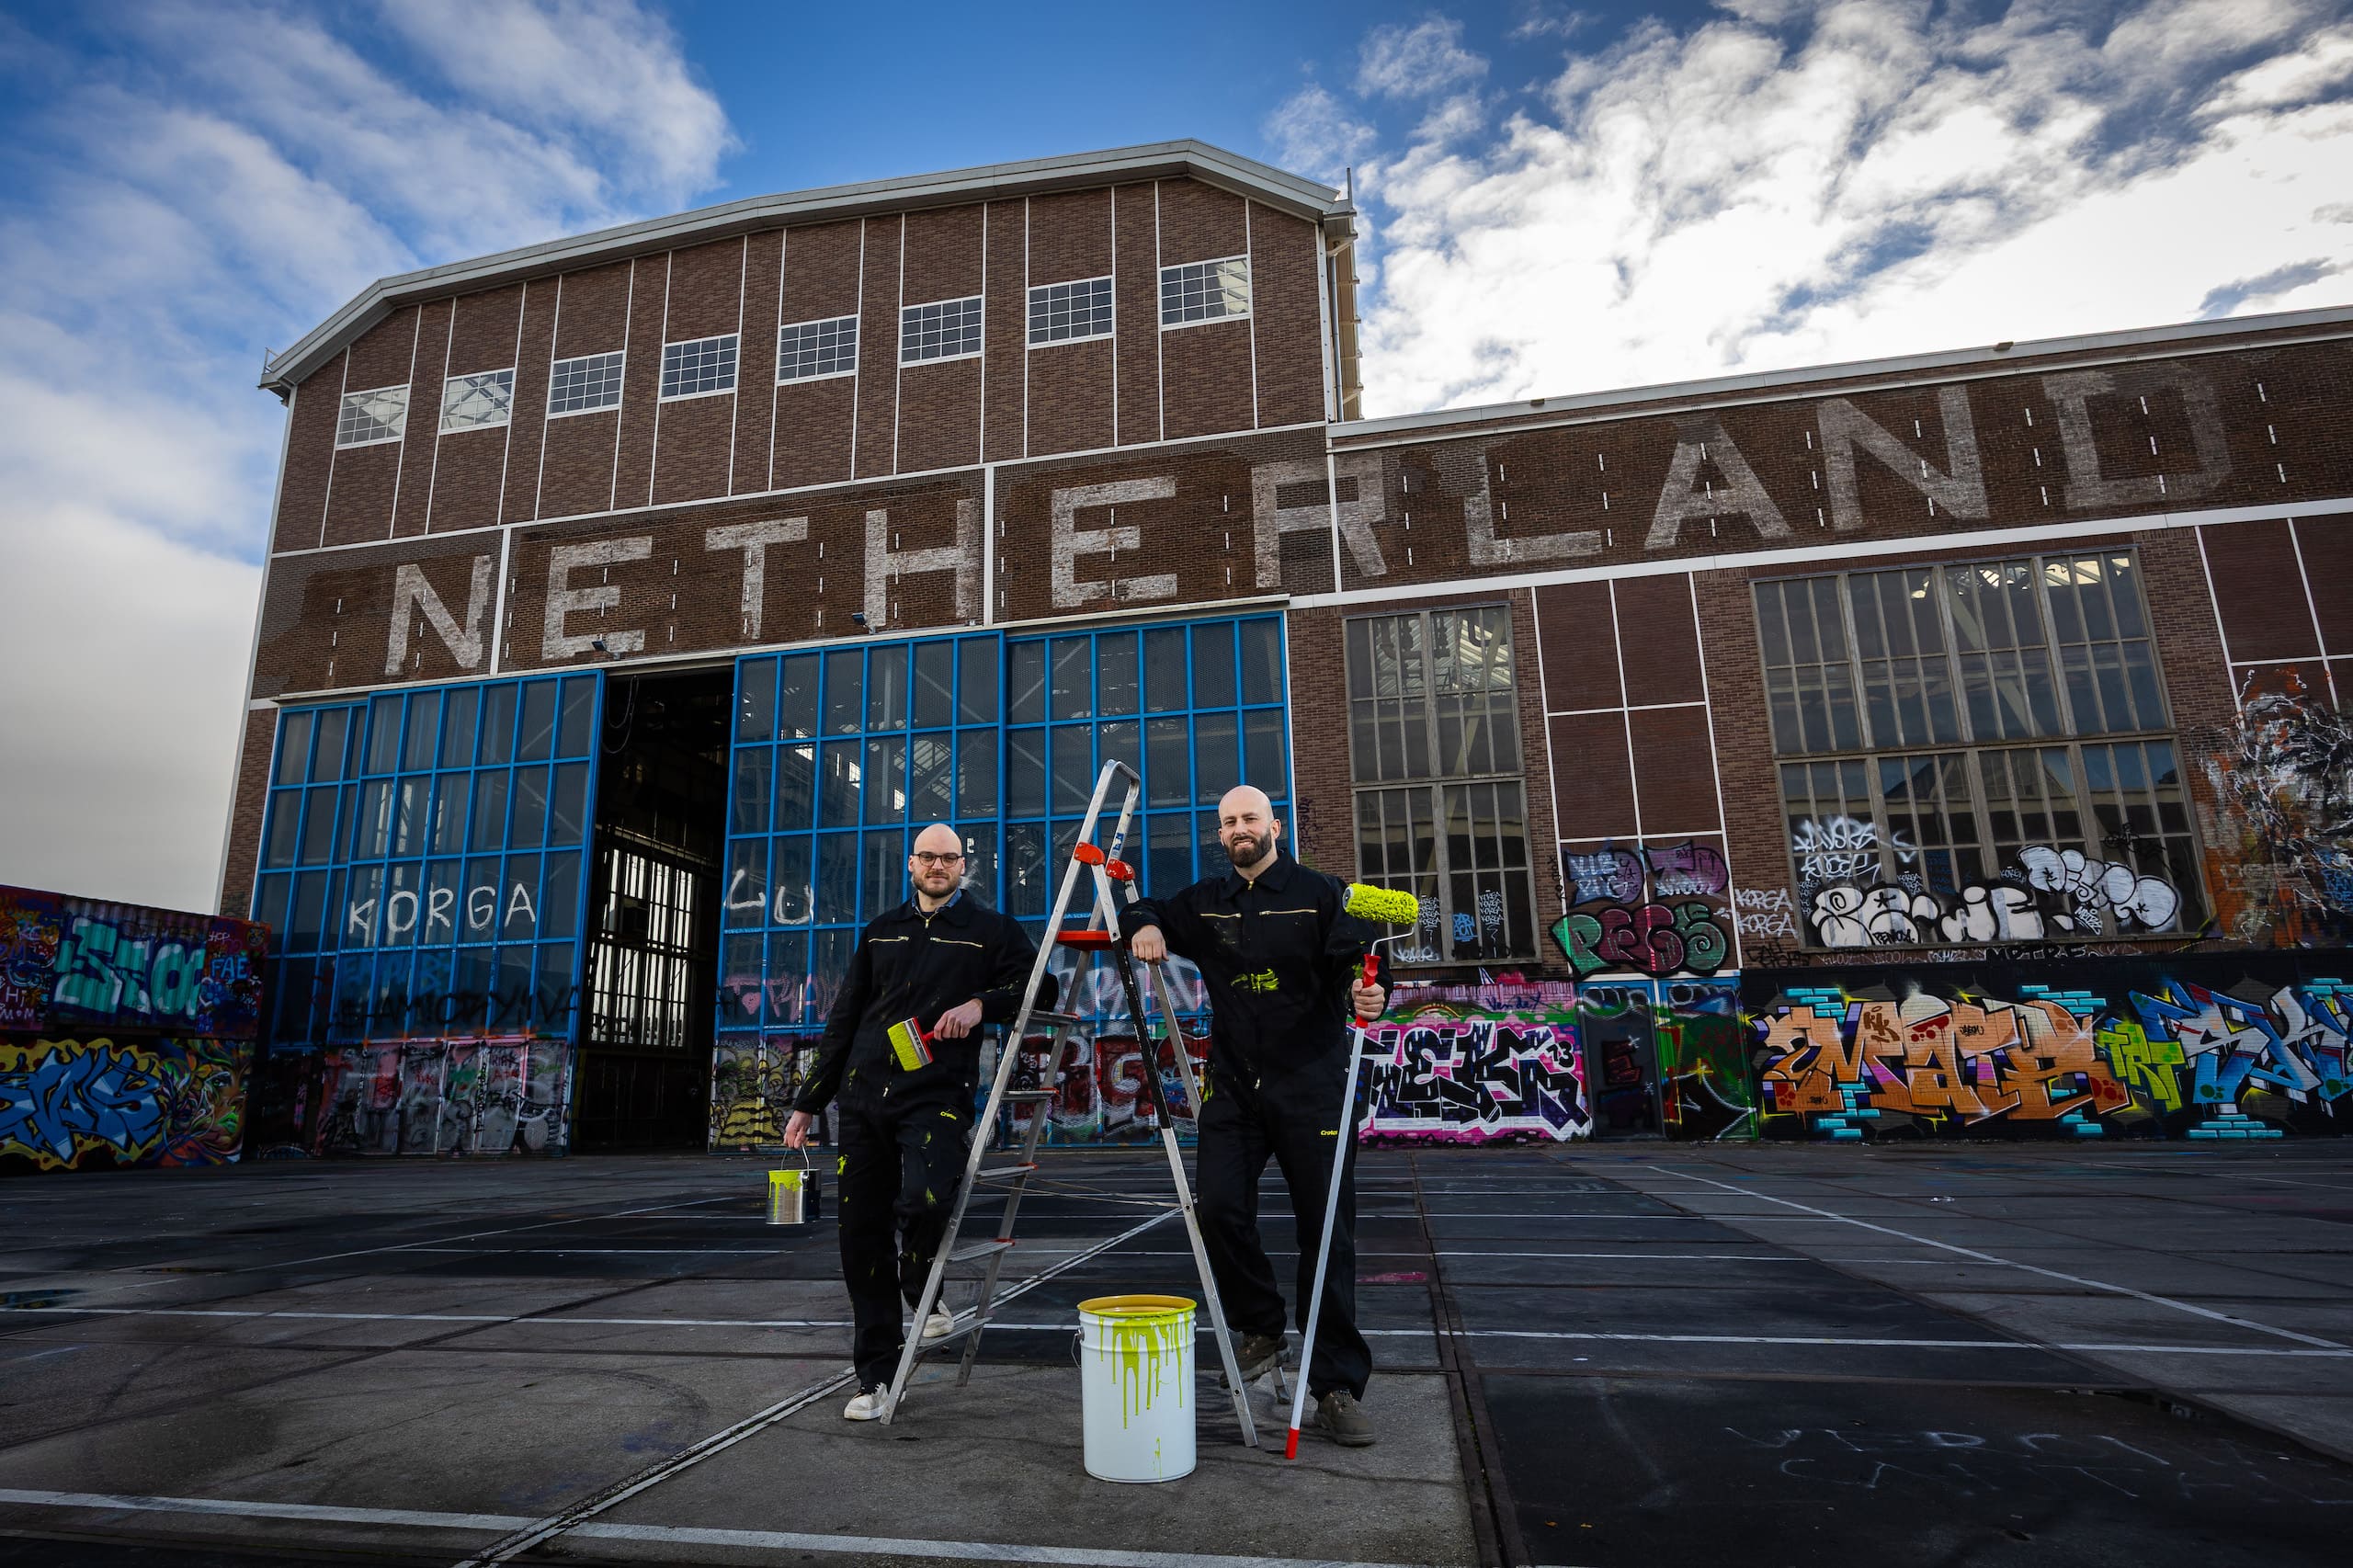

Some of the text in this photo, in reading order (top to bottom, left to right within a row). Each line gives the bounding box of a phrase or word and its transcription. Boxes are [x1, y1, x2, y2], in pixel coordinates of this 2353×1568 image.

[385, 362, 2235, 677] NETHERLAND
[348, 882, 537, 935] KORGA
[1734, 887, 1794, 912] KORGA
[1736, 912, 1800, 939] KORGA
